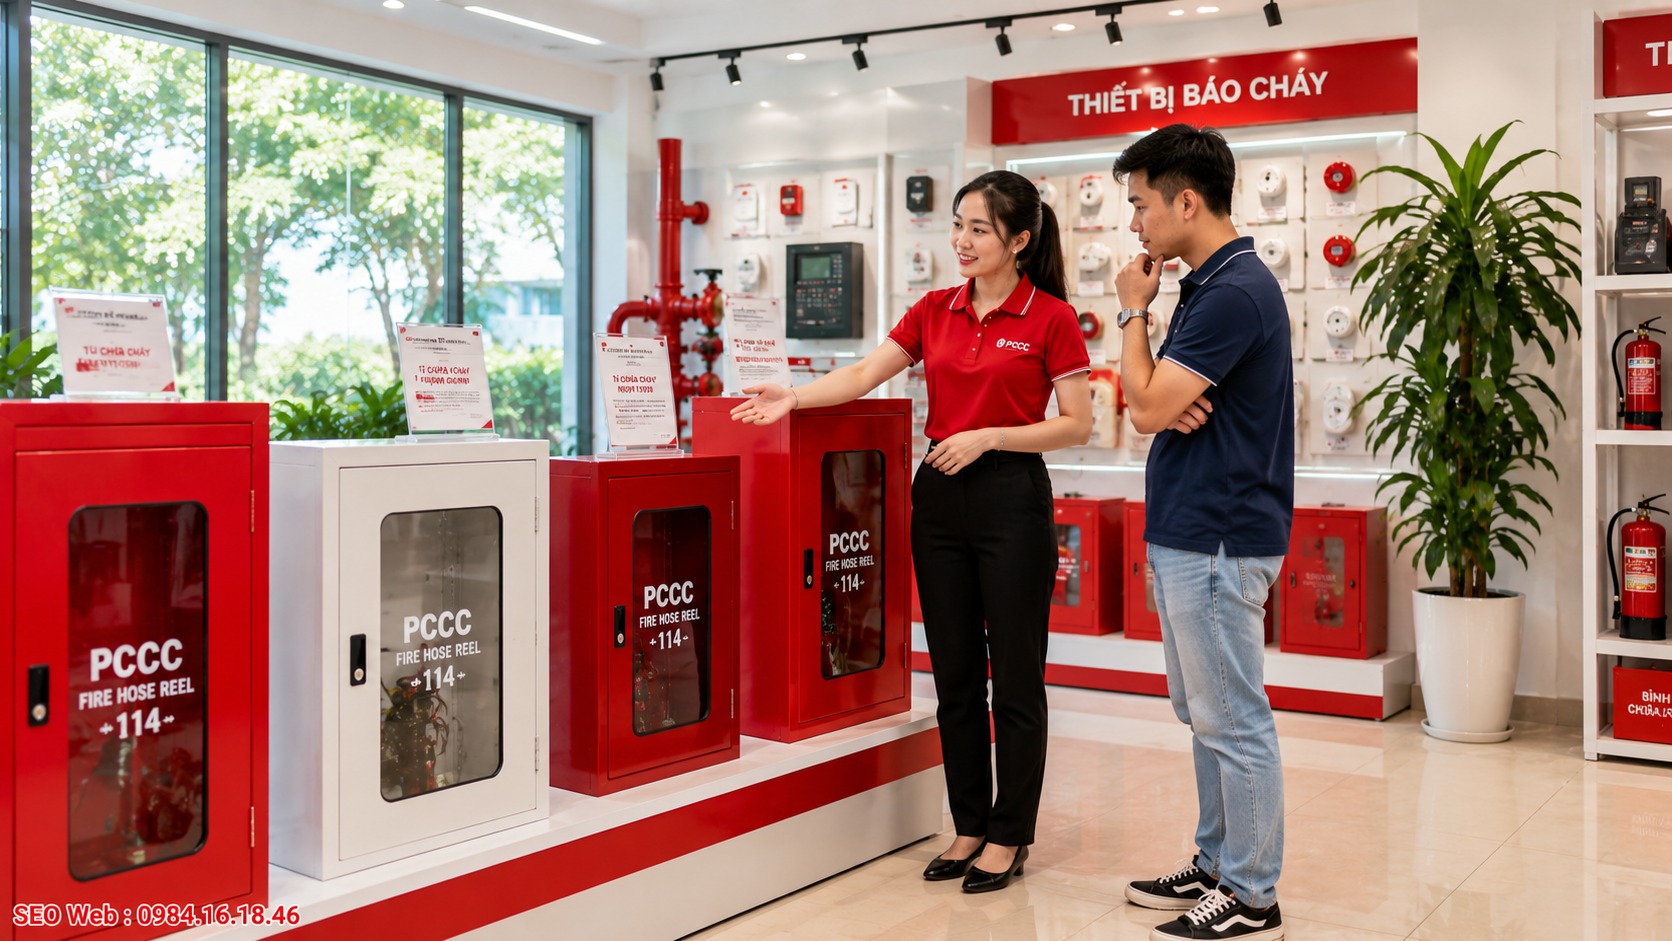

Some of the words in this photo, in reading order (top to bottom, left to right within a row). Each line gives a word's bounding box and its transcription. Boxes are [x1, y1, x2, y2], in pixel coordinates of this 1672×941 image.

[1067, 81, 1142, 117] THIẾT
[1150, 85, 1174, 114] BỊ
[1183, 76, 1241, 107] BÁO
[1249, 67, 1328, 101] CHÁY
[1005, 340, 1030, 351] PCCC
[829, 530, 869, 555] PCCC
[825, 560, 839, 572] FIRE
[644, 580, 693, 609] PCCC
[404, 608, 471, 643] PCCC
[639, 615, 656, 628] FIRE
[659, 611, 679, 625] HOSE
[681, 608, 700, 621] REEL
[90, 638, 183, 682] PCCC
[396, 650, 420, 666] FIRE
[423, 645, 452, 662] HOSE
[455, 641, 481, 657] REEL
[79, 688, 113, 710] FIRE
[117, 682, 156, 703] HOSE
[160, 677, 195, 697] REEL
